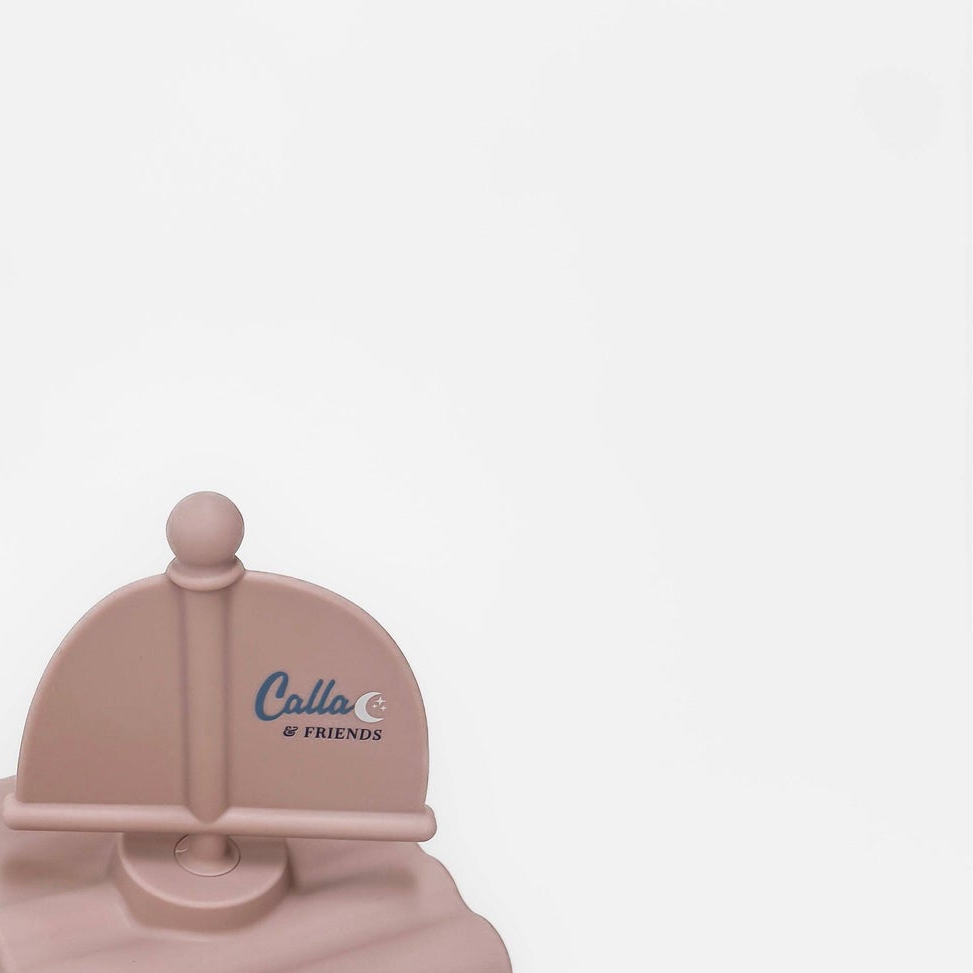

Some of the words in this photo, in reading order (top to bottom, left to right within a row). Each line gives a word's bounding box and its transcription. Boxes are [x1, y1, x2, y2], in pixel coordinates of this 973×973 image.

[254, 671, 356, 721] Calla
[283, 725, 298, 737] &
[304, 726, 382, 741] FRIENDS
